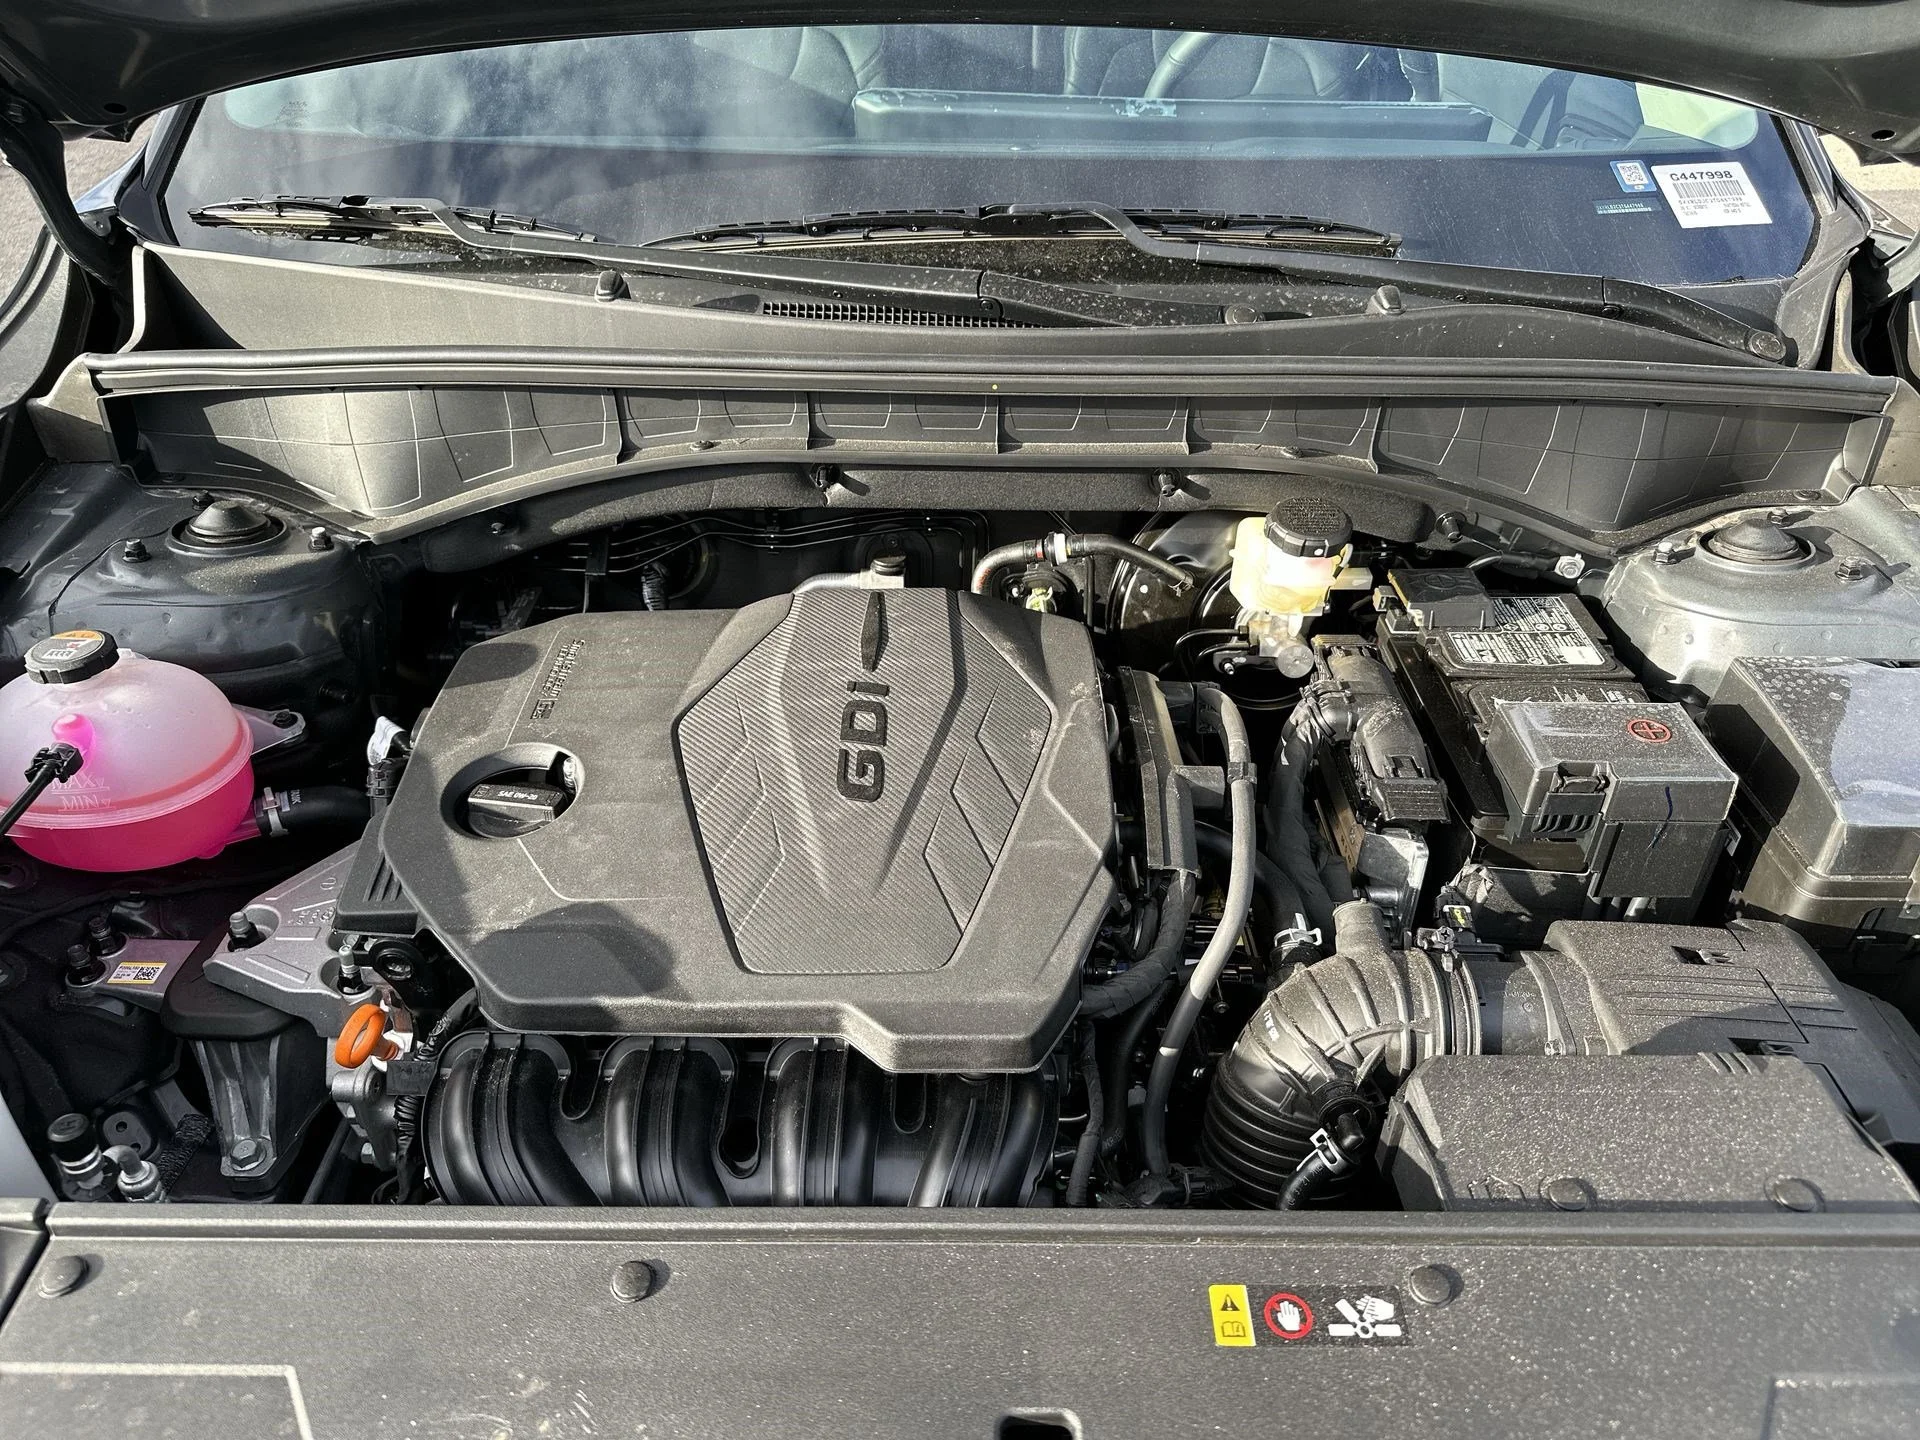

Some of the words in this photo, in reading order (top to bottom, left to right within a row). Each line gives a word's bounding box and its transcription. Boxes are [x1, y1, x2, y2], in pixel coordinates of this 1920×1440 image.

[1669, 170, 1733, 182] G447998
[497, 790, 513, 798] SAE
[60, 795, 99, 810] MIN
